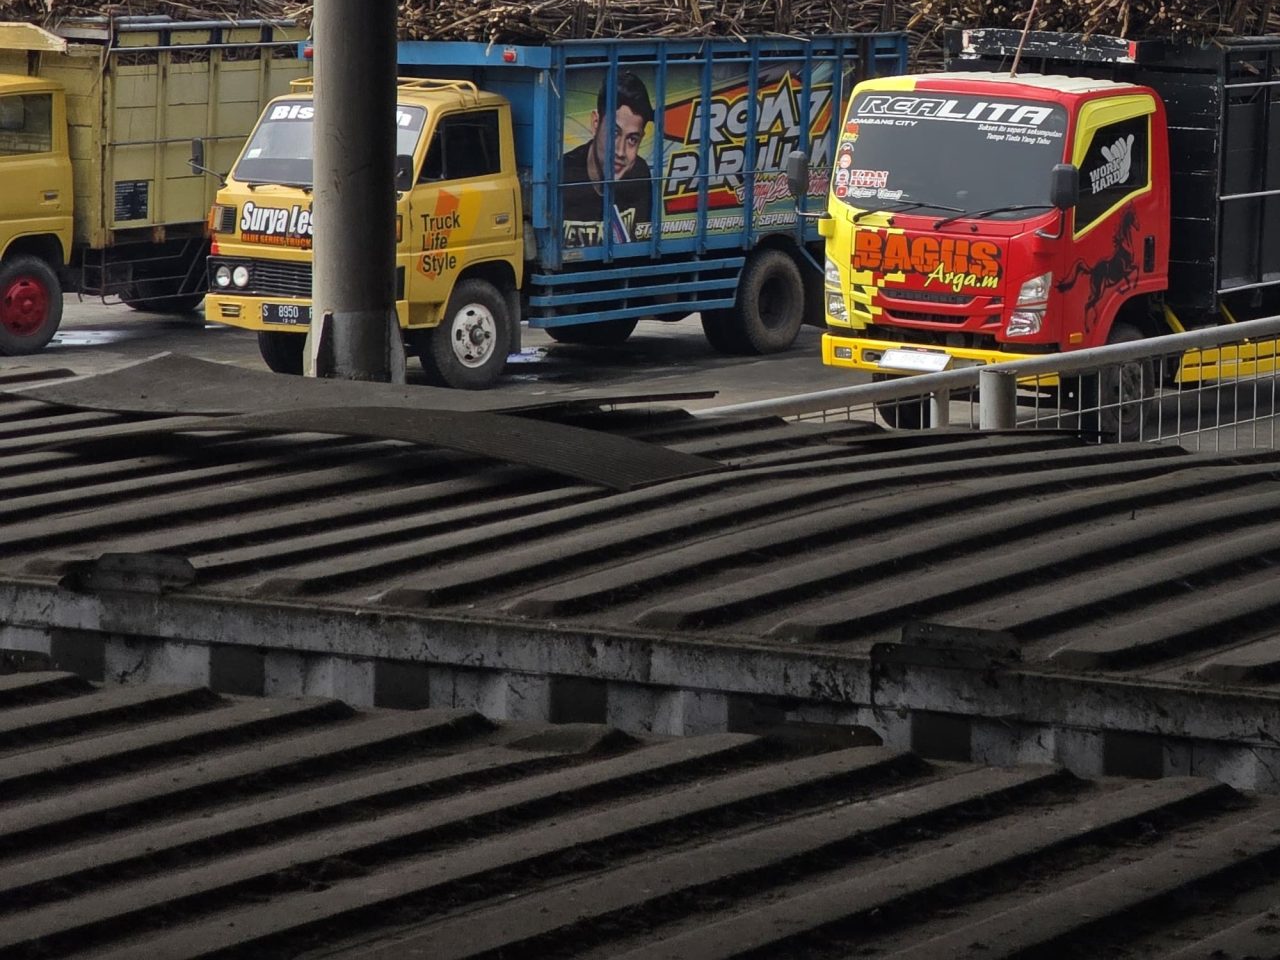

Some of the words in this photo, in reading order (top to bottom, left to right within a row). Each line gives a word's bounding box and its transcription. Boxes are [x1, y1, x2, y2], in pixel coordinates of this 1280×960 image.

[1089, 157, 1121, 182] WORK
[1092, 170, 1121, 194] HARD
[240, 201, 289, 235] Surya
[420, 210, 461, 232] Truck
[422, 231, 448, 252] Life
[422, 252, 457, 276] Style
[853, 230, 1001, 278] BAGUS
[923, 261, 999, 292] Arga.m
[262, 304, 269, 317] S
[278, 305, 299, 319] 8950
